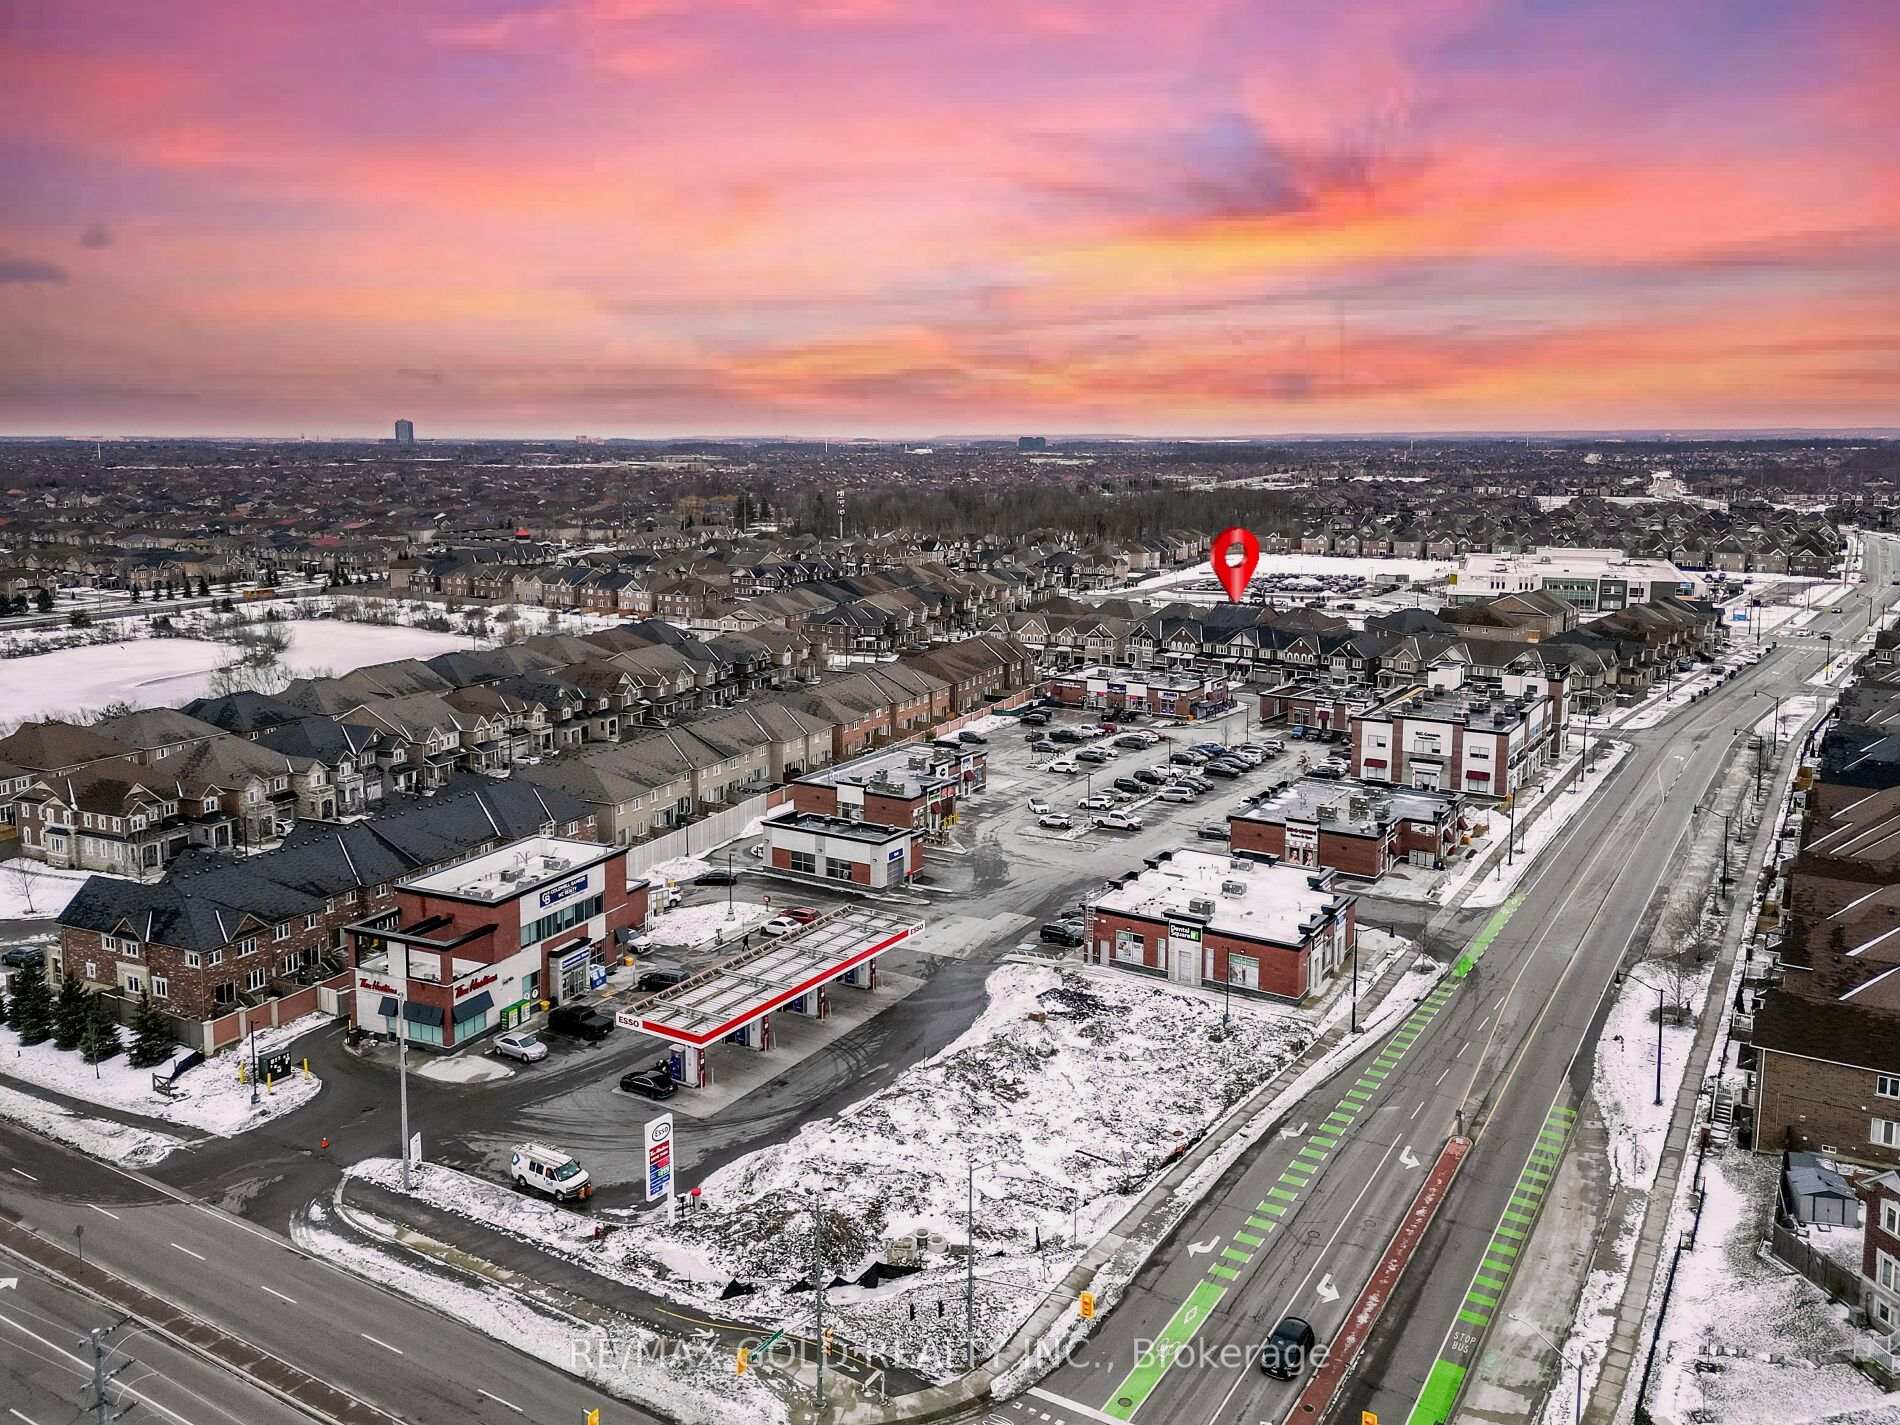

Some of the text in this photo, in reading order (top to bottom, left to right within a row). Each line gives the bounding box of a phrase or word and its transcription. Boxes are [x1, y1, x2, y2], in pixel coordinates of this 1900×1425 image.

[1171, 925, 1189, 933] Dental
[1171, 930, 1190, 938] Square
[1453, 1331, 1477, 1344] STOP
[1451, 1340, 1470, 1354] BUS
